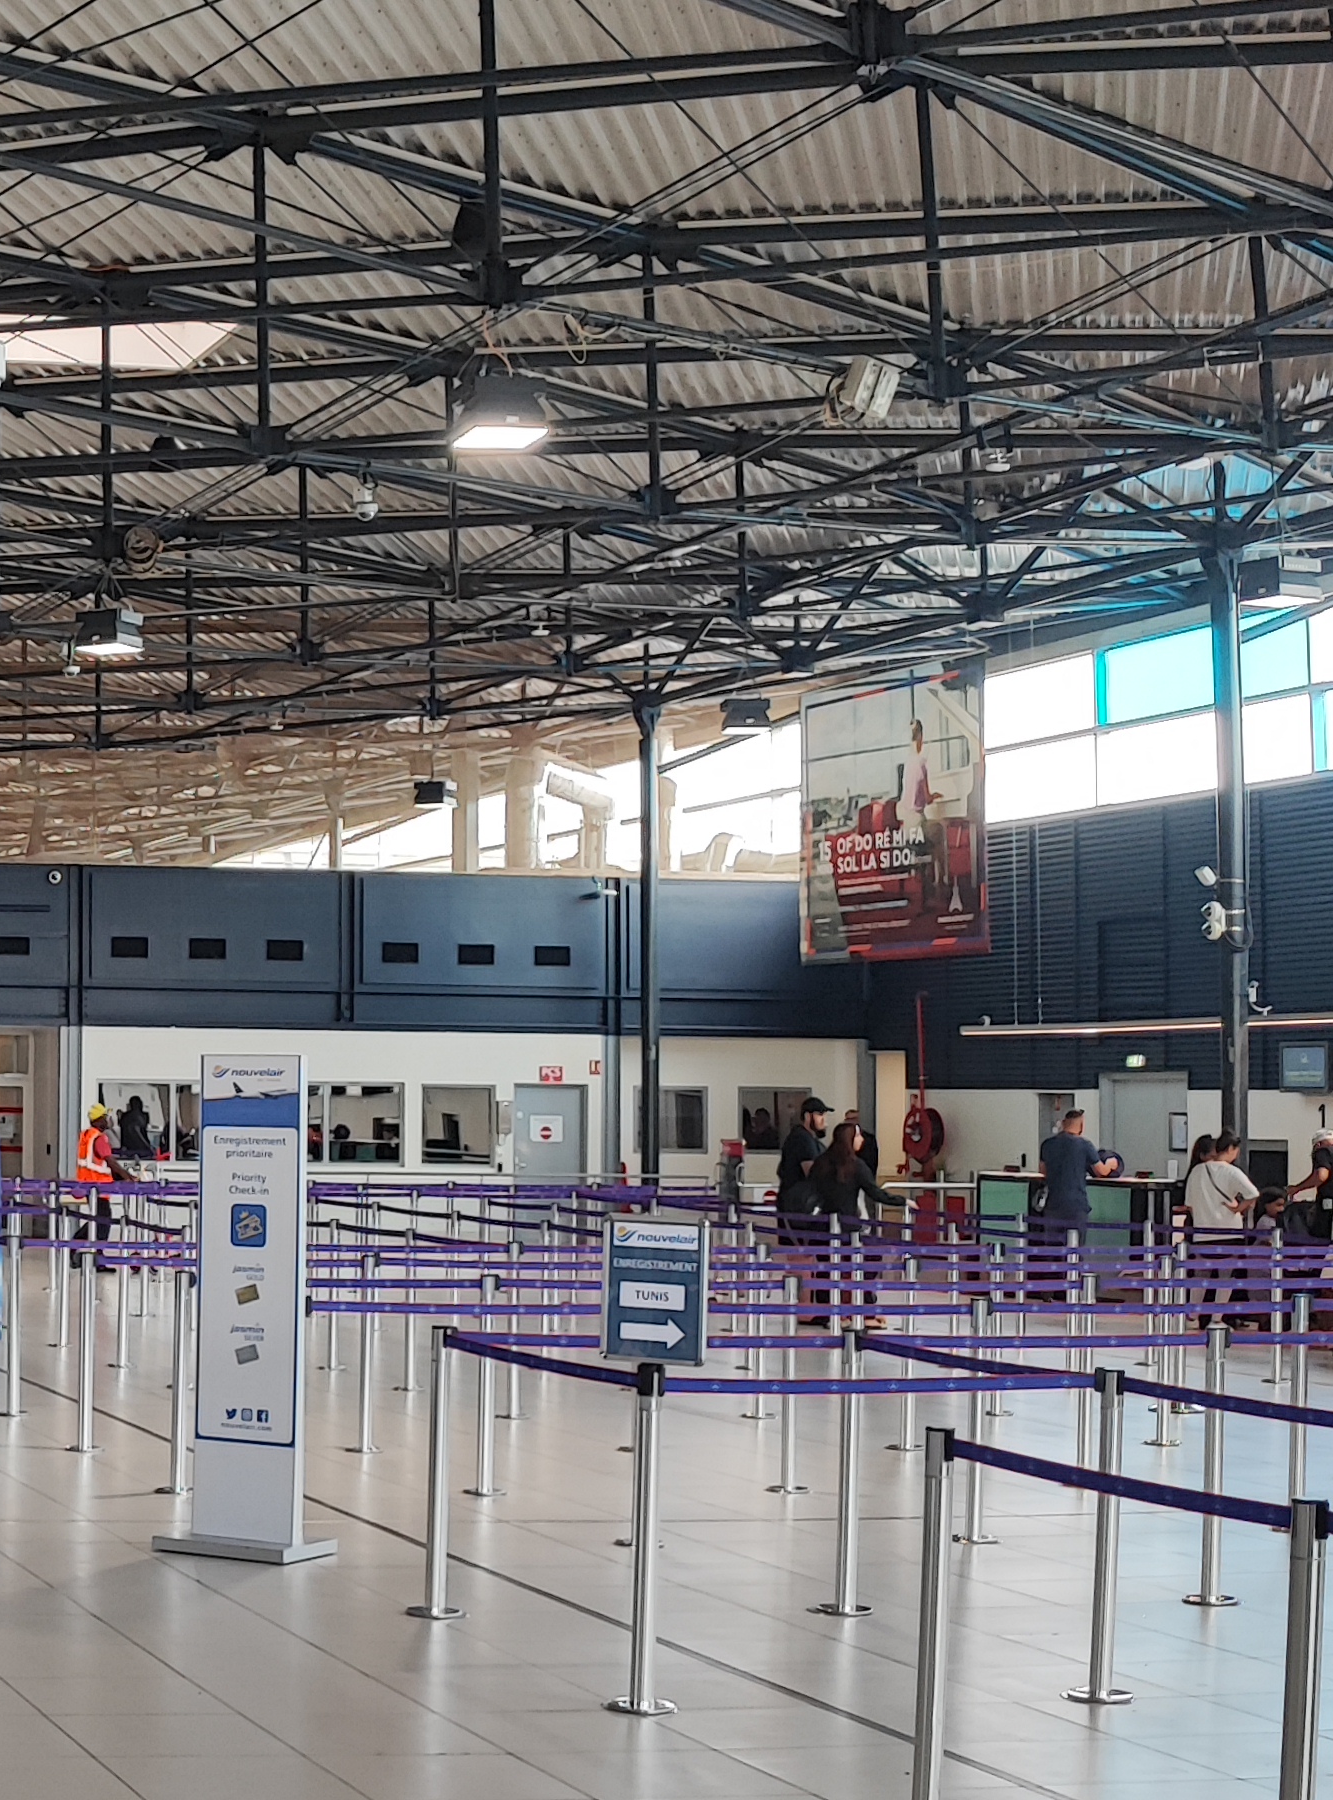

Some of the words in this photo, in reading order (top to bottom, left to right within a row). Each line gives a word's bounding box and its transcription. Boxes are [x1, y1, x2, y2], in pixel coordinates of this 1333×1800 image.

[854, 833, 873, 853] DO
[874, 825, 892, 850] RÉ
[893, 826, 907, 848] MI
[908, 825, 926, 846] FA
[837, 855, 860, 875] SOL
[861, 852, 878, 871] LA
[880, 849, 891, 869] SI
[893, 847, 911, 868] DO
[230, 1067, 286, 1077] nouvelair
[213, 1135, 287, 1148] Enregistrement
[225, 1149, 274, 1160] prioritaire
[231, 1172, 267, 1184] Priority
[228, 1184, 270, 1196] Check-in
[636, 1232, 698, 1245] nouvelair
[613, 1257, 699, 1273] ENREGISTREMENT
[634, 1289, 670, 1303] TUNIS
